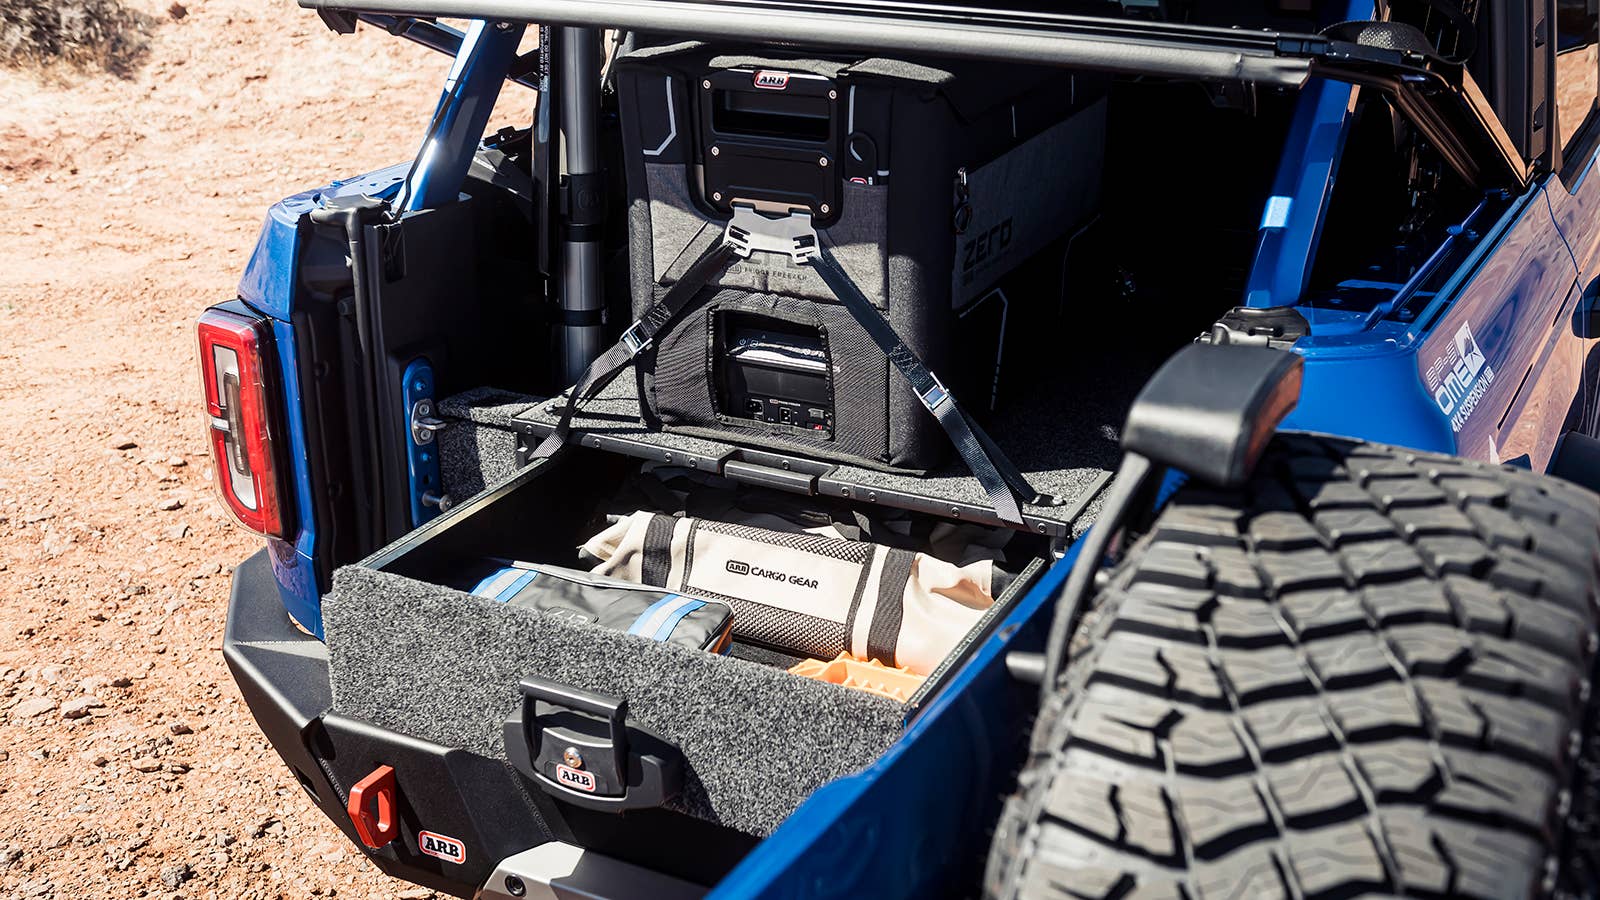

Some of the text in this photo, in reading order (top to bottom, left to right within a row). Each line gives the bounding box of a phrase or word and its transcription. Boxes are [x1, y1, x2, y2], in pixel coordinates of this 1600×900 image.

[1460, 374, 1491, 420] SUSPENSION
[751, 567, 786, 582] CARGO
[788, 576, 819, 589] GEAR
[562, 769, 590, 786] ARB
[425, 836, 460, 858] ARB
